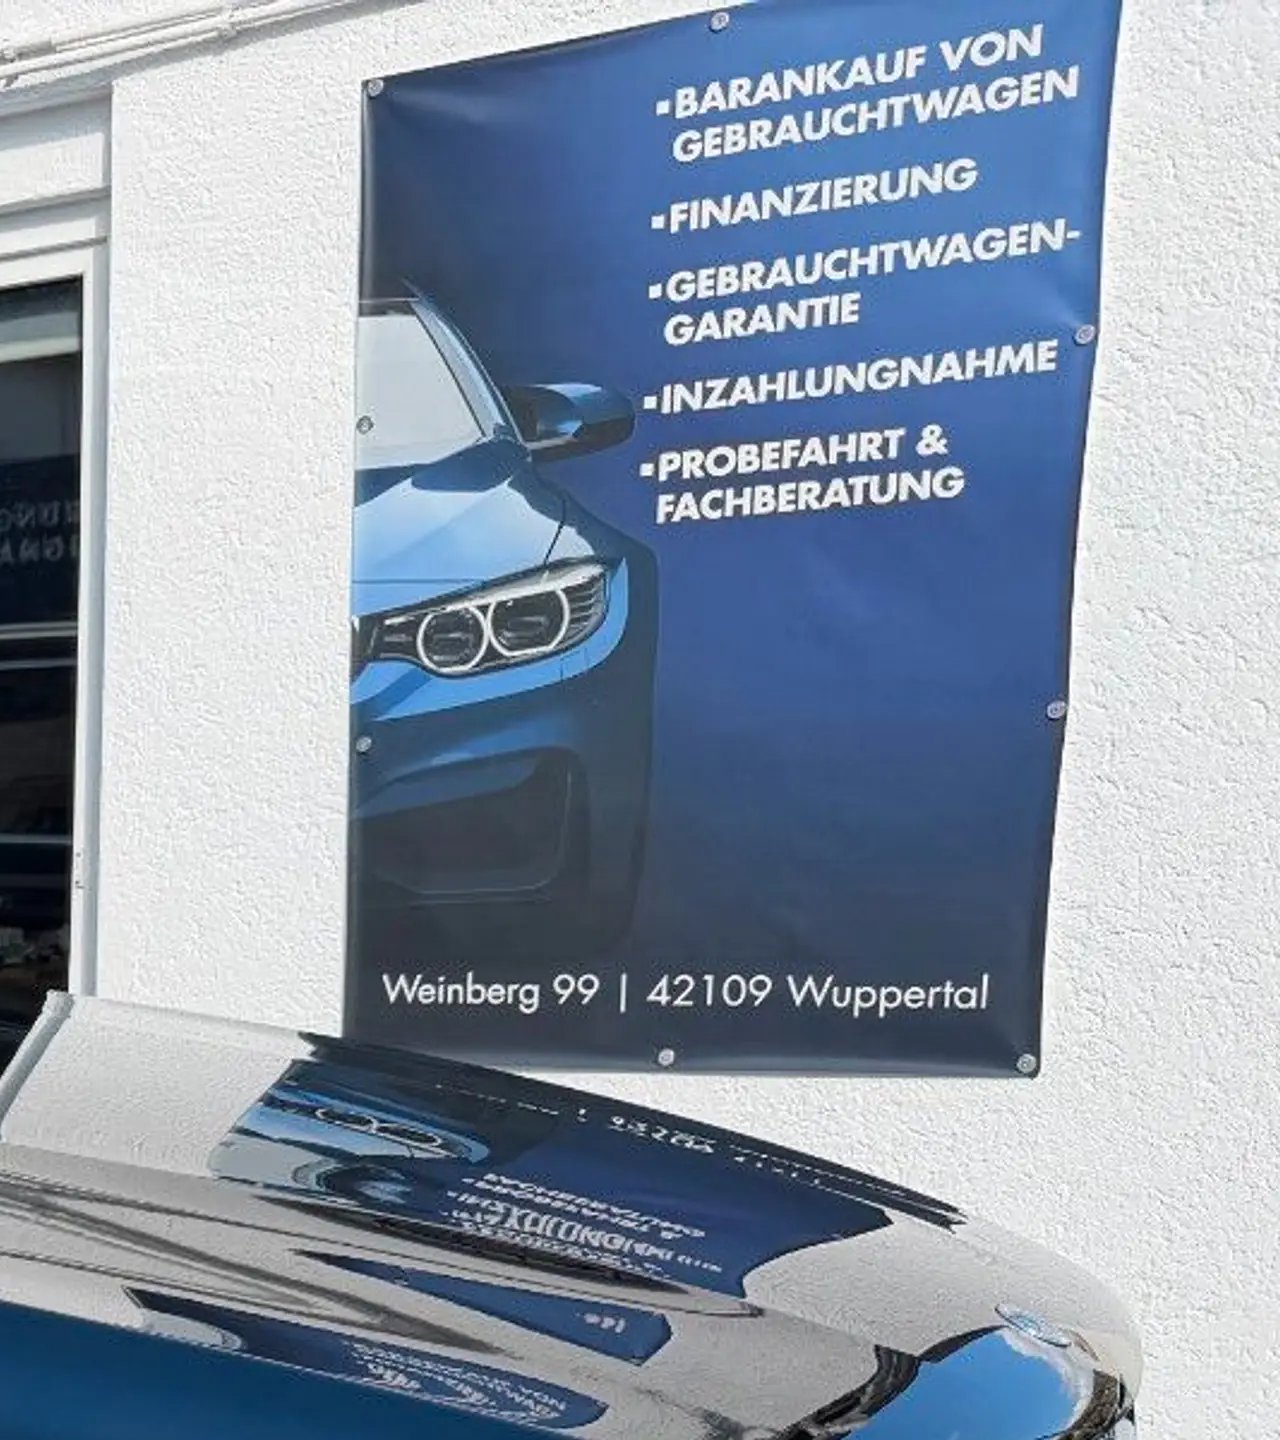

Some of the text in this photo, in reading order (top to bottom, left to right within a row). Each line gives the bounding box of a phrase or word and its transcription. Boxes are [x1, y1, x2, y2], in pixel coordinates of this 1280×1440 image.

[674, 24, 1044, 119] BARANKAUF VON
[672, 66, 1080, 162] GEBRAUCHTWAGEN
[669, 158, 979, 234] FINANZIERUNG
[666, 218, 1081, 303] GEBRAUCHTWAGEN-
[663, 291, 861, 346] GARANTIE
[661, 338, 1058, 414] INZAHLUNGNAHME
[658, 424, 948, 482] PROBEFAHRT &
[656, 466, 965, 524] FACHBERATUNG
[382, 971, 540, 1014] Weinberg
[553, 973, 600, 1005] 99
[646, 974, 773, 1007] 42109
[787, 973, 989, 1018] Wuppertal
